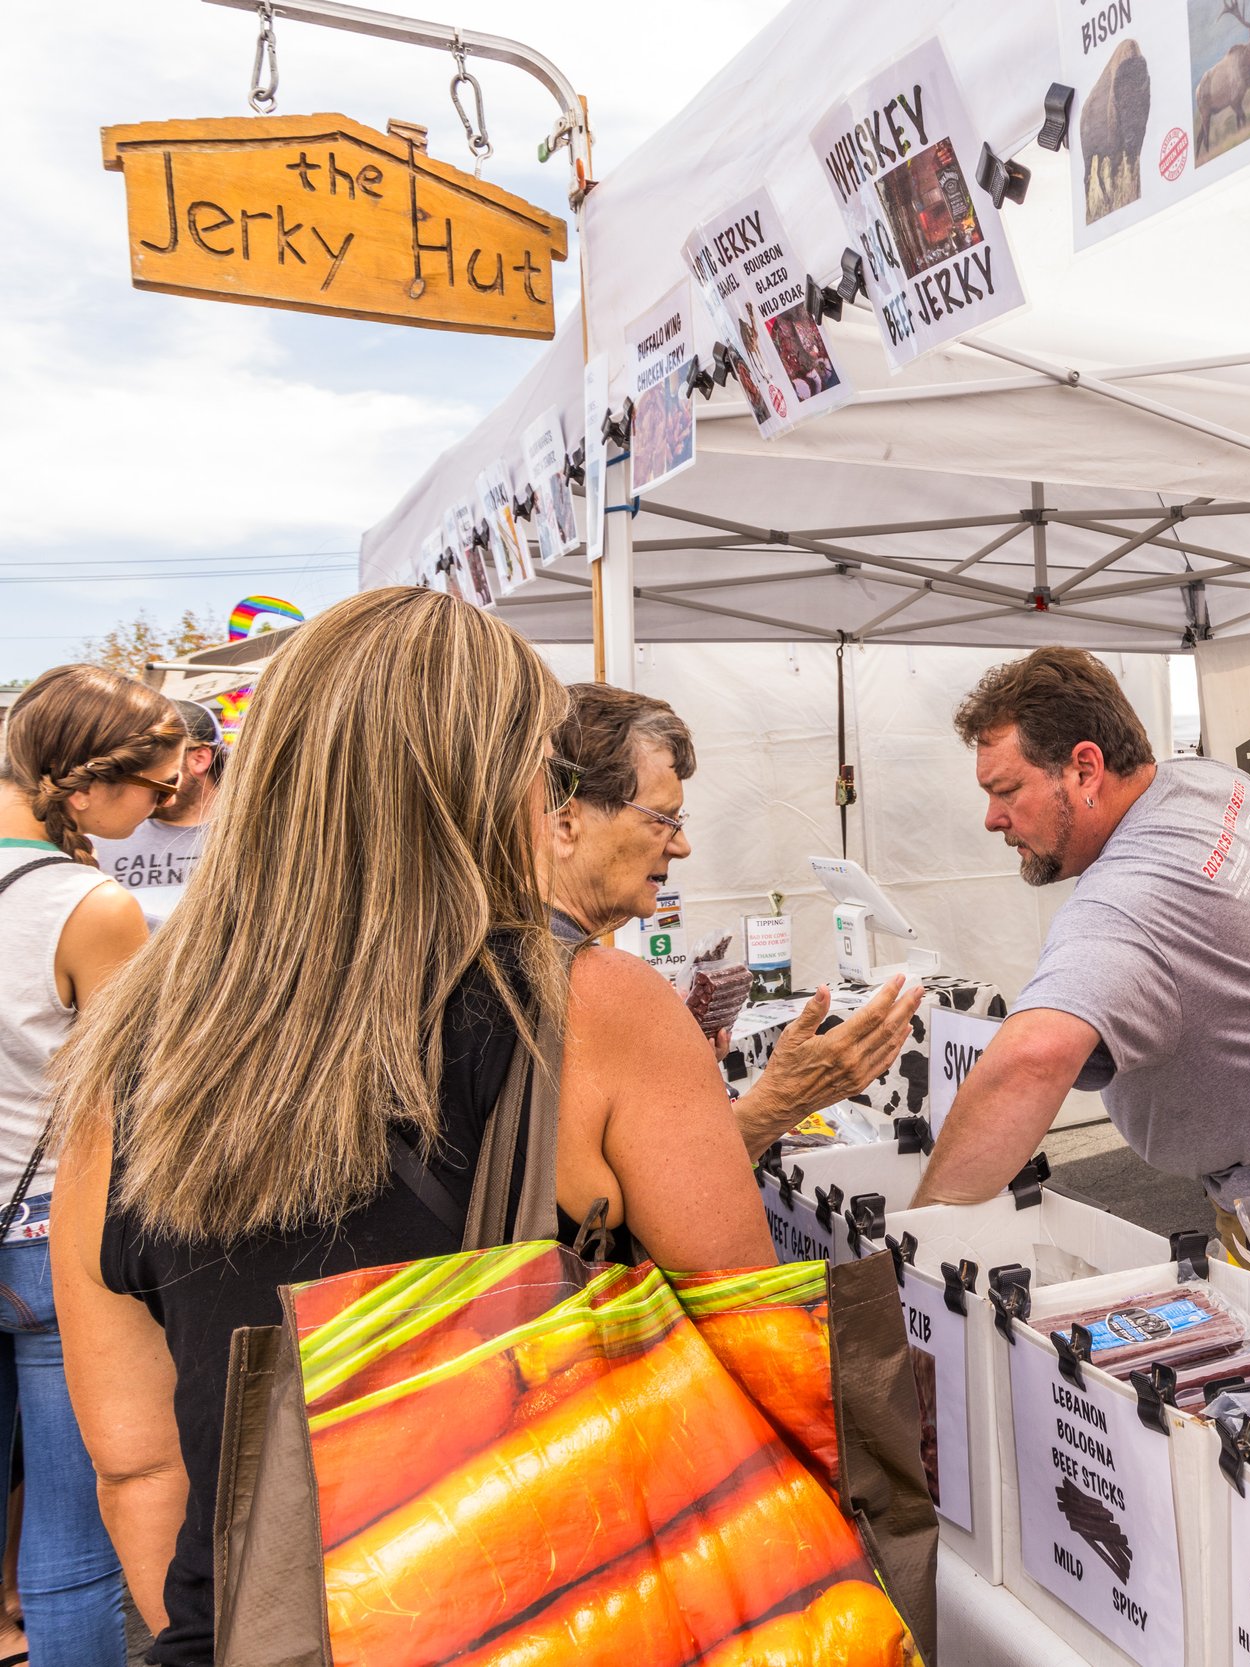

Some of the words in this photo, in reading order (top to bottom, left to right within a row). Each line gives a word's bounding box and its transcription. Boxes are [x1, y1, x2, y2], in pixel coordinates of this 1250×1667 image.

[1081, 0, 1132, 55] BISON
[826, 85, 928, 203] WHISKEY
[286, 152, 384, 198] the
[140, 150, 354, 291] Jerky
[409, 178, 546, 304] Hut
[713, 210, 765, 268] JERKY
[743, 243, 784, 276] BOURBON
[755, 266, 788, 294] GLAZED
[757, 298, 780, 318] WILD
[780, 283, 805, 306] BOAR
[882, 291, 915, 346] BEEF
[914, 246, 995, 326] JERKY
[637, 327, 664, 362] BUFFALO
[664, 312, 682, 342] WING
[637, 359, 664, 392] CHICKEN
[664, 342, 685, 374] JERKY
[1202, 848, 1225, 879] 2023
[660, 900, 676, 908] VISA
[646, 956, 664, 966] ash
[664, 953, 687, 964] App
[765, 1206, 789, 1249] WEET
[909, 1306, 932, 1344] RIB
[1052, 1382, 1108, 1435] LEBANON
[1056, 1417, 1116, 1473] BOLOGNA
[1052, 1446, 1080, 1480] BEEF
[1081, 1470, 1126, 1512] STICKS
[1053, 1541, 1084, 1582] MILD
[1111, 1586, 1149, 1632] SPICY
